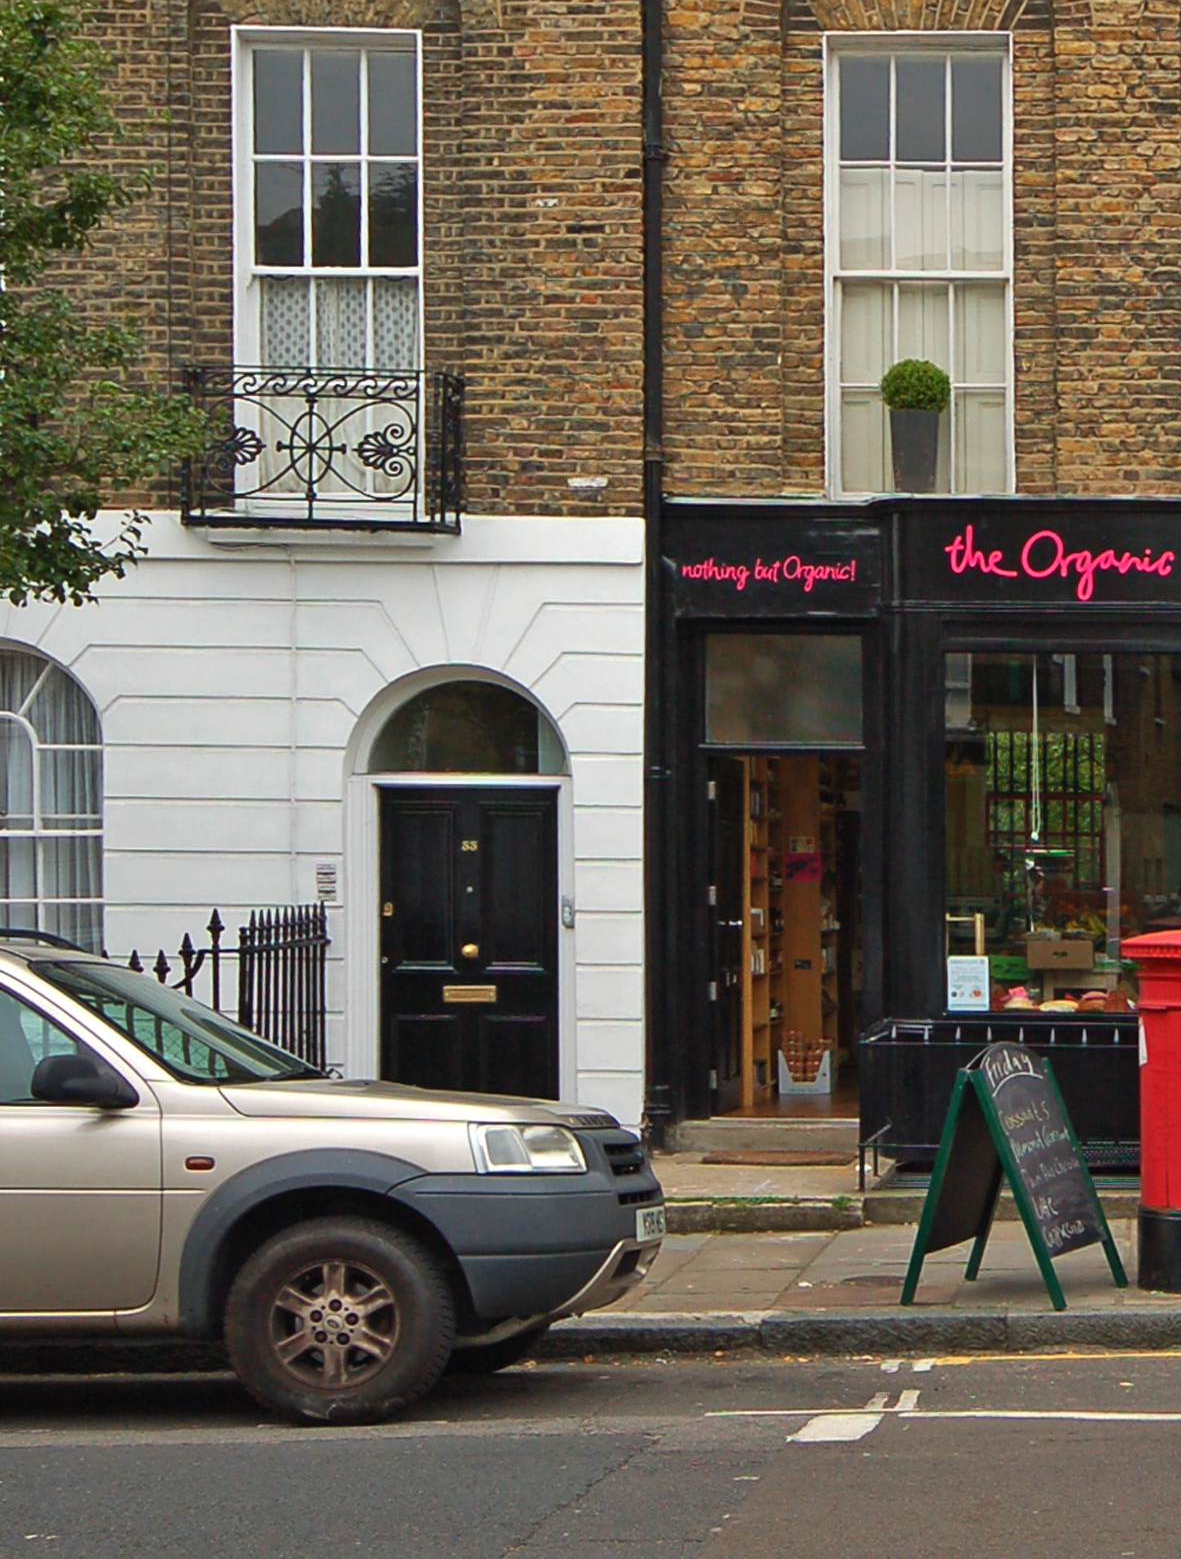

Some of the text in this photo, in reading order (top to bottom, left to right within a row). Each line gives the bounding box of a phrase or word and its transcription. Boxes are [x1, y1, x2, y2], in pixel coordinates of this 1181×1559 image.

[681, 555, 857, 592] nothing but Organic!
[945, 524, 1018, 577] the
[1021, 530, 1175, 601] Organic
